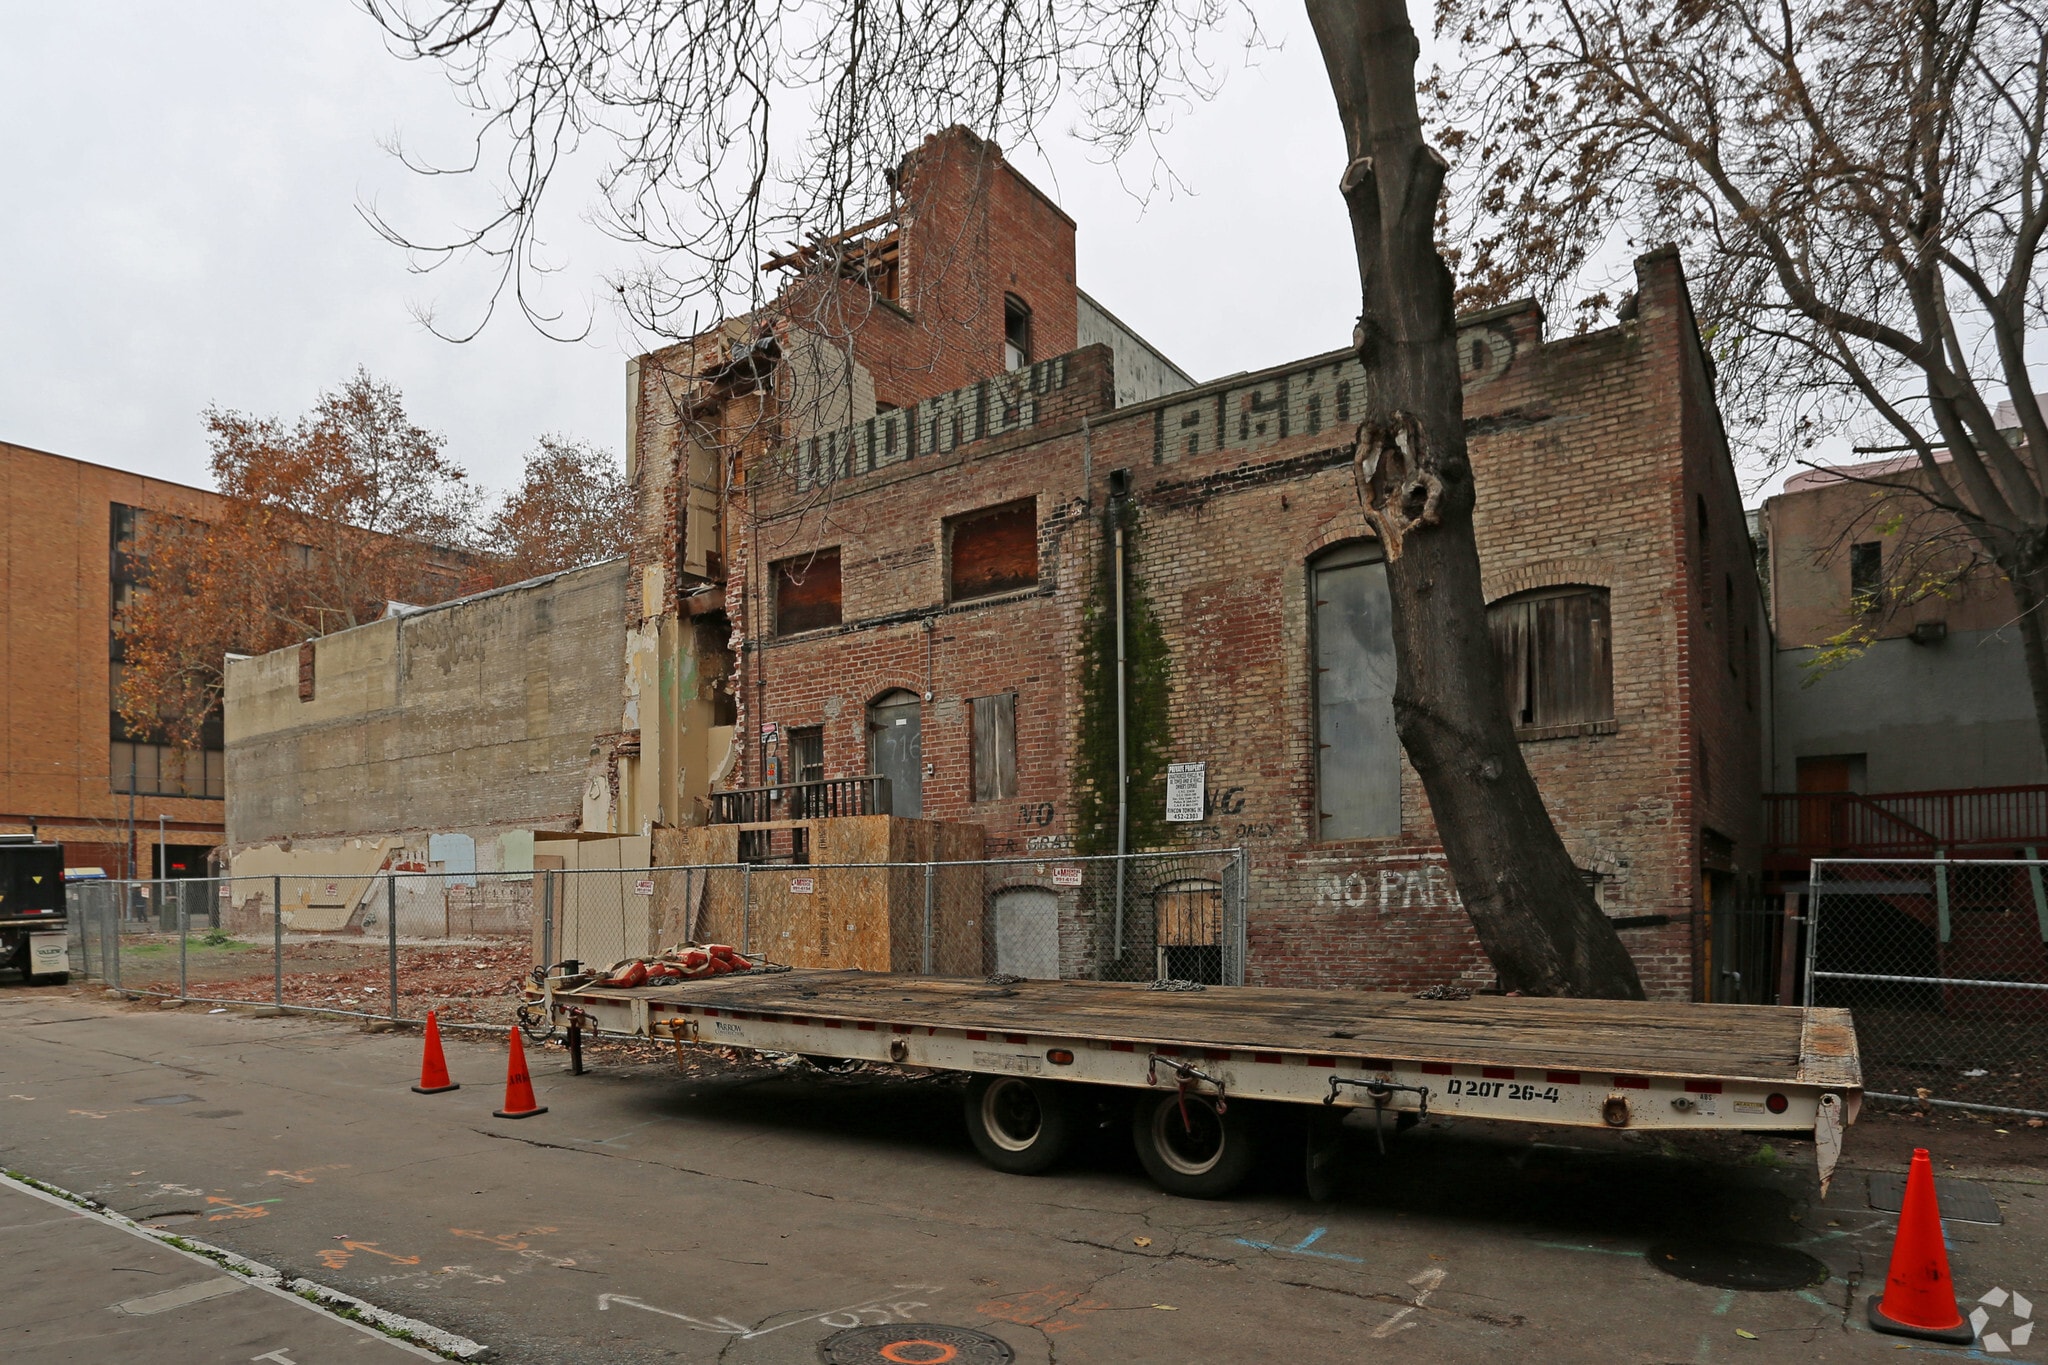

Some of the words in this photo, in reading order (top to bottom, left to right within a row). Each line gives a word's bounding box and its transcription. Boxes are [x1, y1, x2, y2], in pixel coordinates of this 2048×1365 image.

[1185, 764, 1204, 772] PROPERTY
[1018, 802, 1055, 827] NO
[1235, 823, 1276, 839] ONLY
[1315, 870, 1367, 911] NO
[1447, 1079, 1462, 1095] D
[1465, 1081, 1505, 1098] 20T
[1508, 1084, 1559, 1103] 26-4
